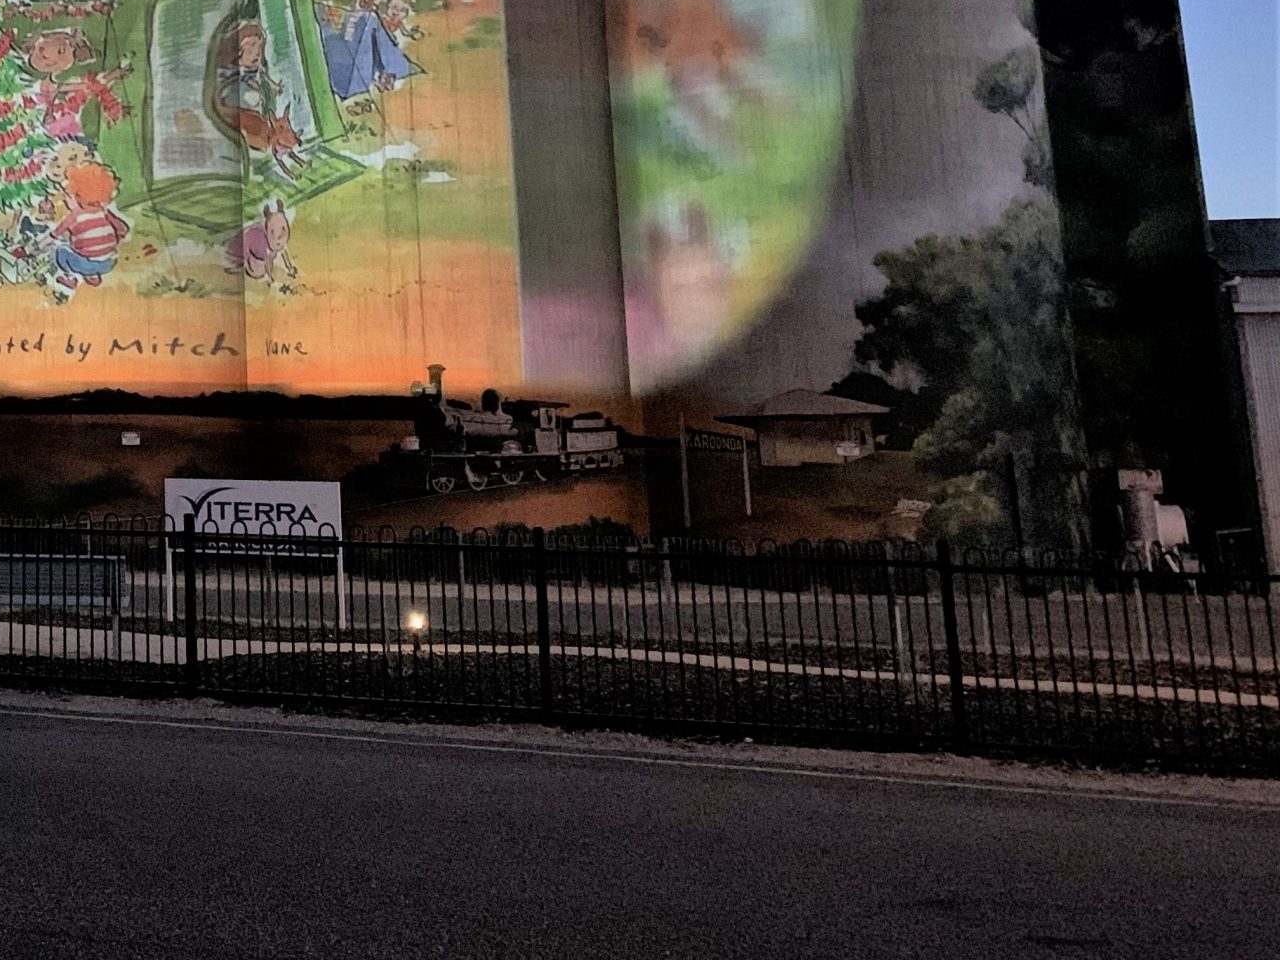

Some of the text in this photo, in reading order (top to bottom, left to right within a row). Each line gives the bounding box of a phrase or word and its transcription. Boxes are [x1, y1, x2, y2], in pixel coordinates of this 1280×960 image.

[65, 334, 92, 362] by
[109, 333, 239, 356] Mitch
[177, 487, 318, 523] VITERRA
